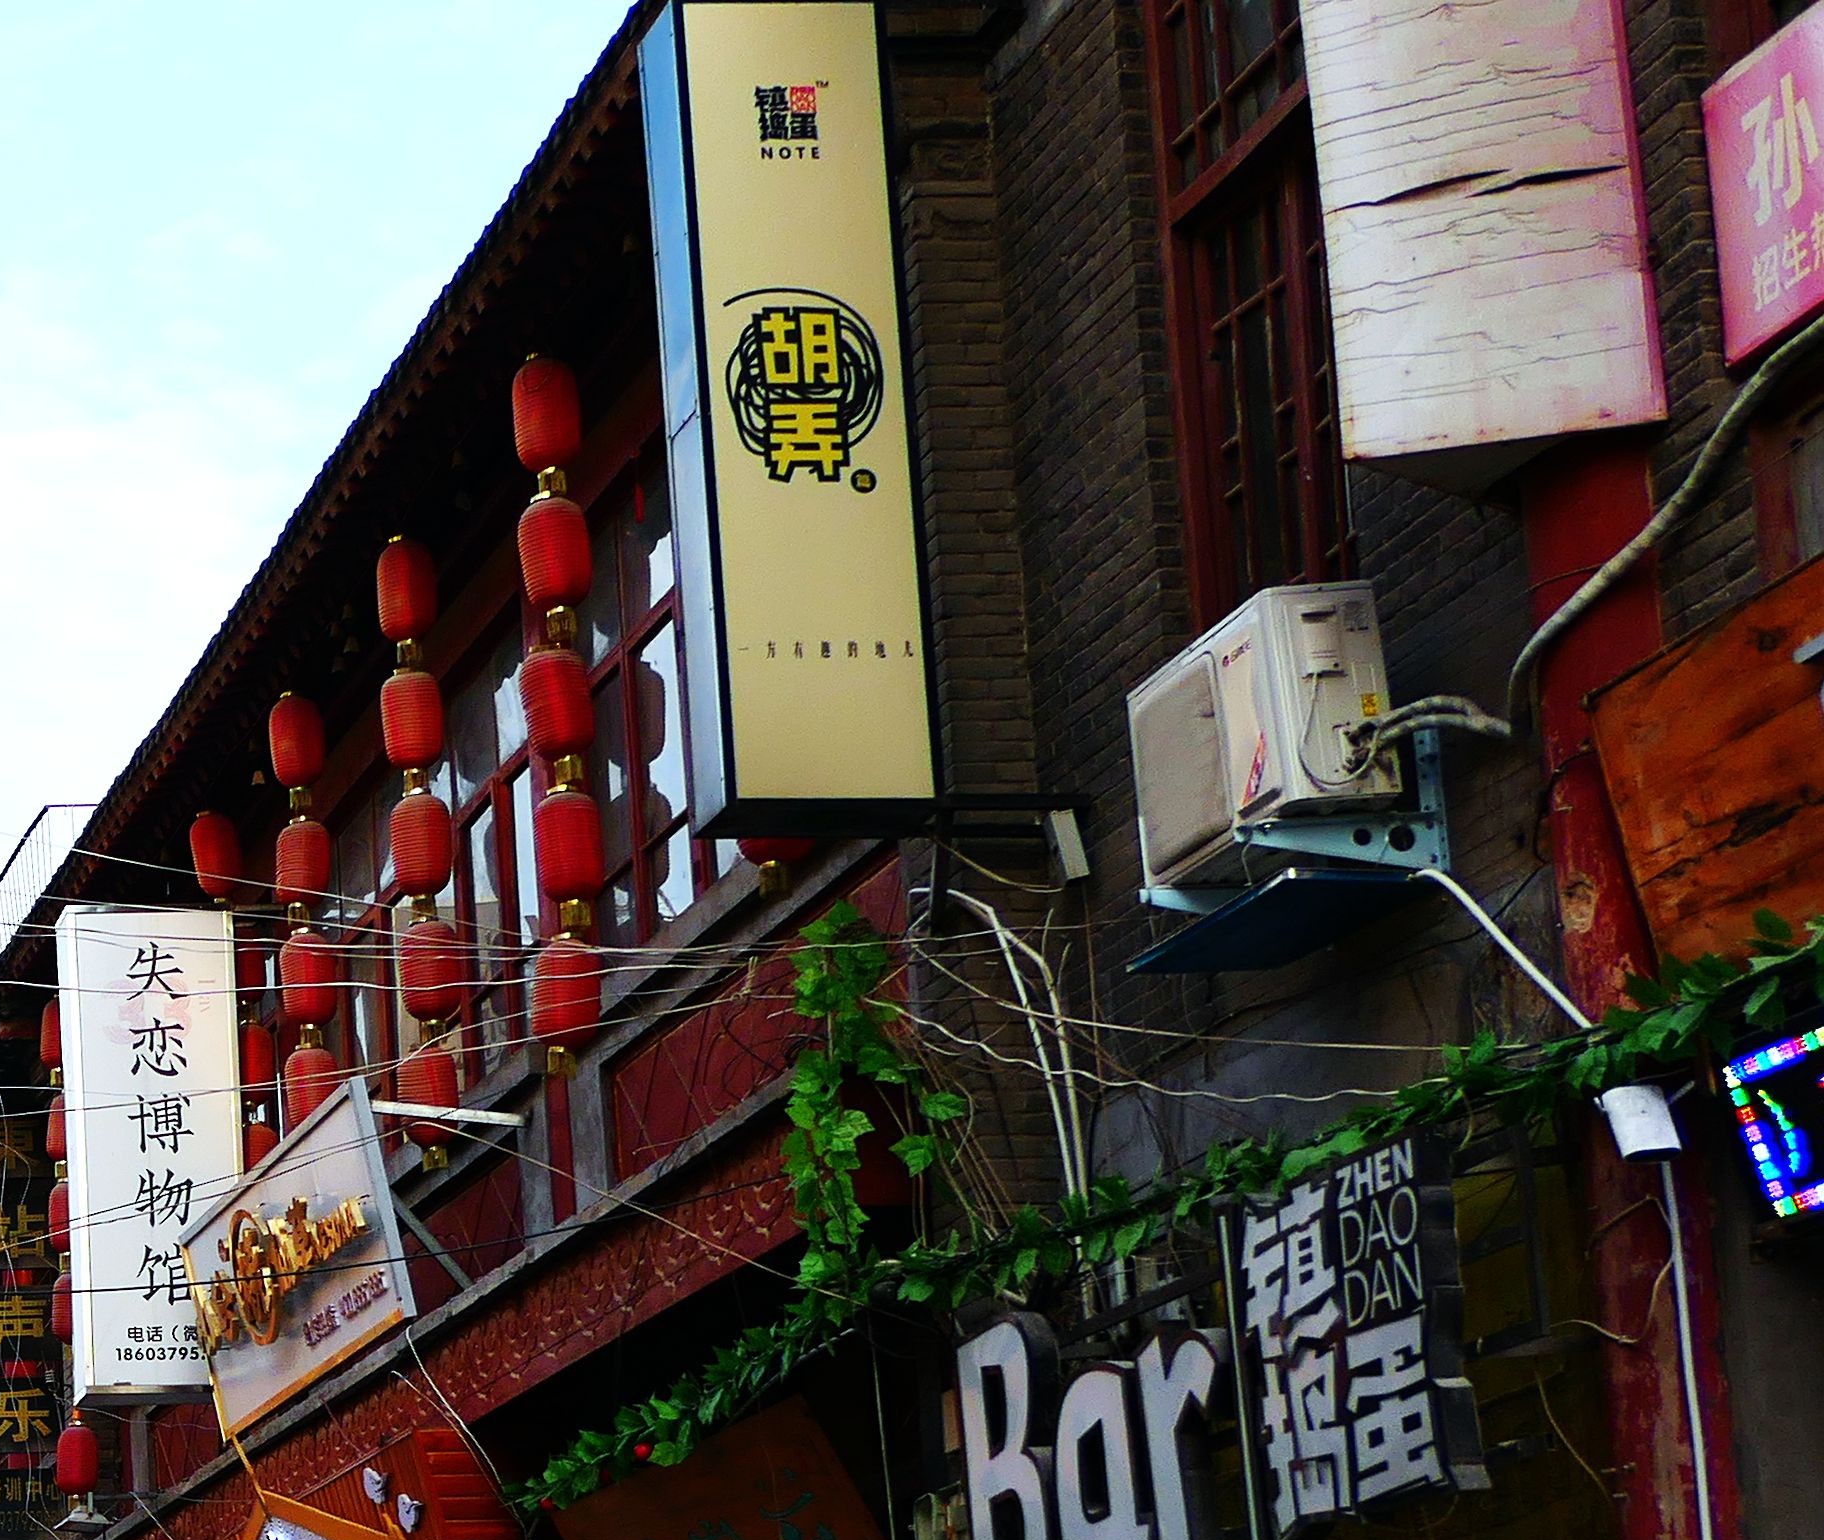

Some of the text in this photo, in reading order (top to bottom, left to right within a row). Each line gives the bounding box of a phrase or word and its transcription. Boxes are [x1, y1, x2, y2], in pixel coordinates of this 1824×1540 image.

[760, 146, 821, 160] NOTE
[754, 307, 849, 482] 胡弄
[126, 941, 195, 1305] 失恋博物馆
[1335, 1138, 1415, 1209] ZHEN
[1338, 1186, 1419, 1270] DAO
[1342, 1243, 1425, 1329] DAN
